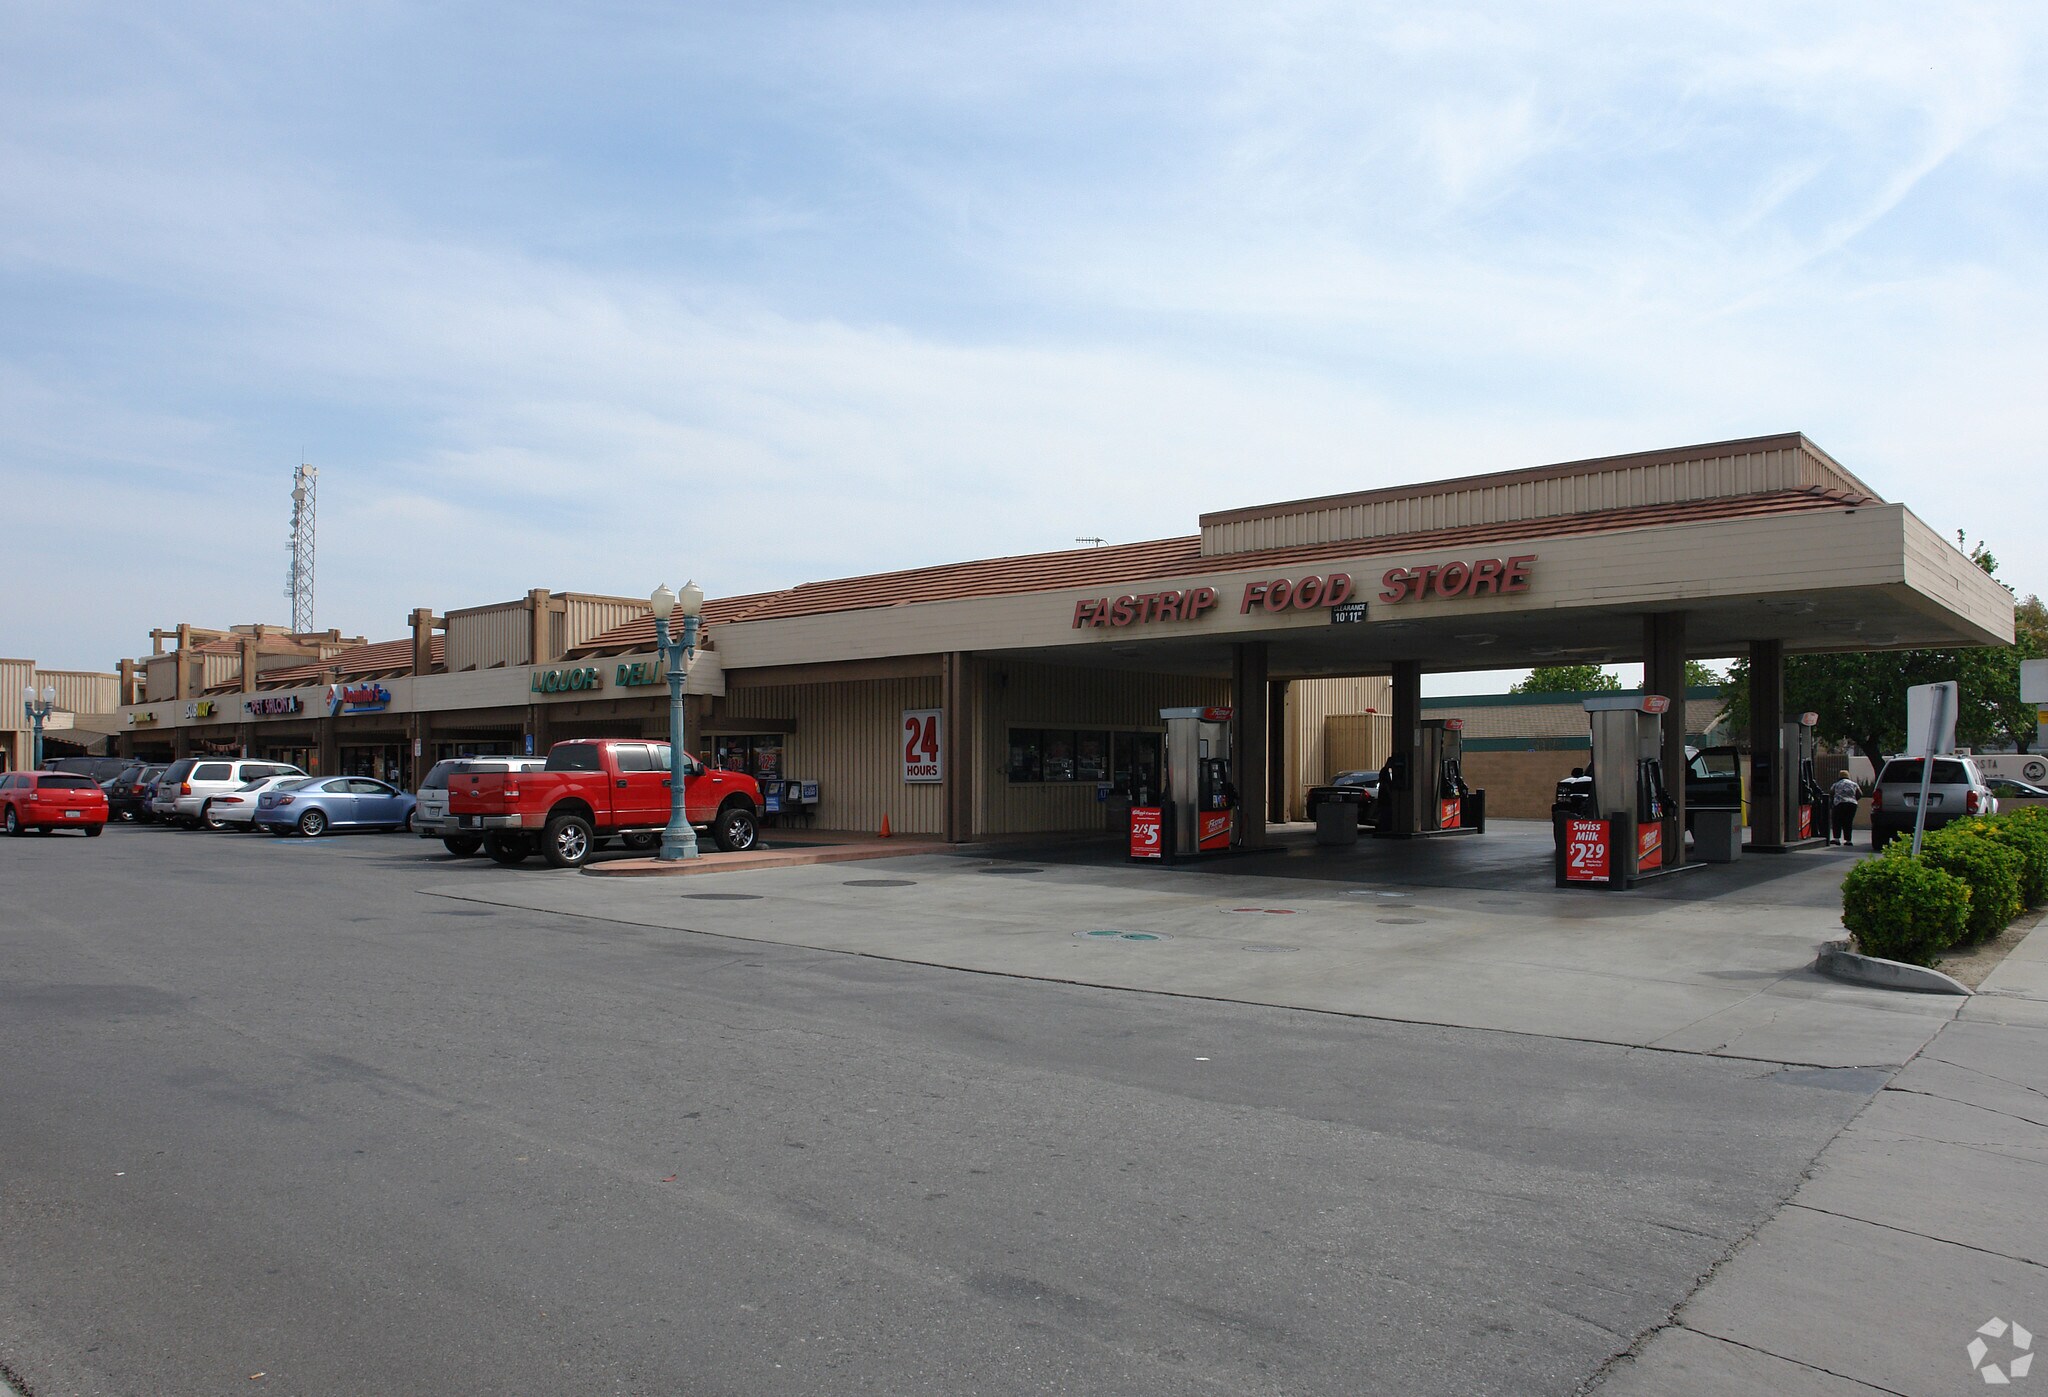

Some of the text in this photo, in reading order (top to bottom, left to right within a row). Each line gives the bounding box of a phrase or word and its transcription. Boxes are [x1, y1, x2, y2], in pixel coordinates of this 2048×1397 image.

[1071, 554, 1538, 630] FASTRIP FOOD STORE
[1334, 603, 1366, 611] CLEARANCE
[531, 660, 663, 693] LIQUOR DELI
[185, 701, 213, 718] SUBWAY
[251, 698, 290, 715] PET SALON
[905, 716, 938, 763] 24
[906, 765, 938, 777] HOURS
[1572, 821, 1601, 831] Swiss
[1575, 831, 1599, 841] Milk
